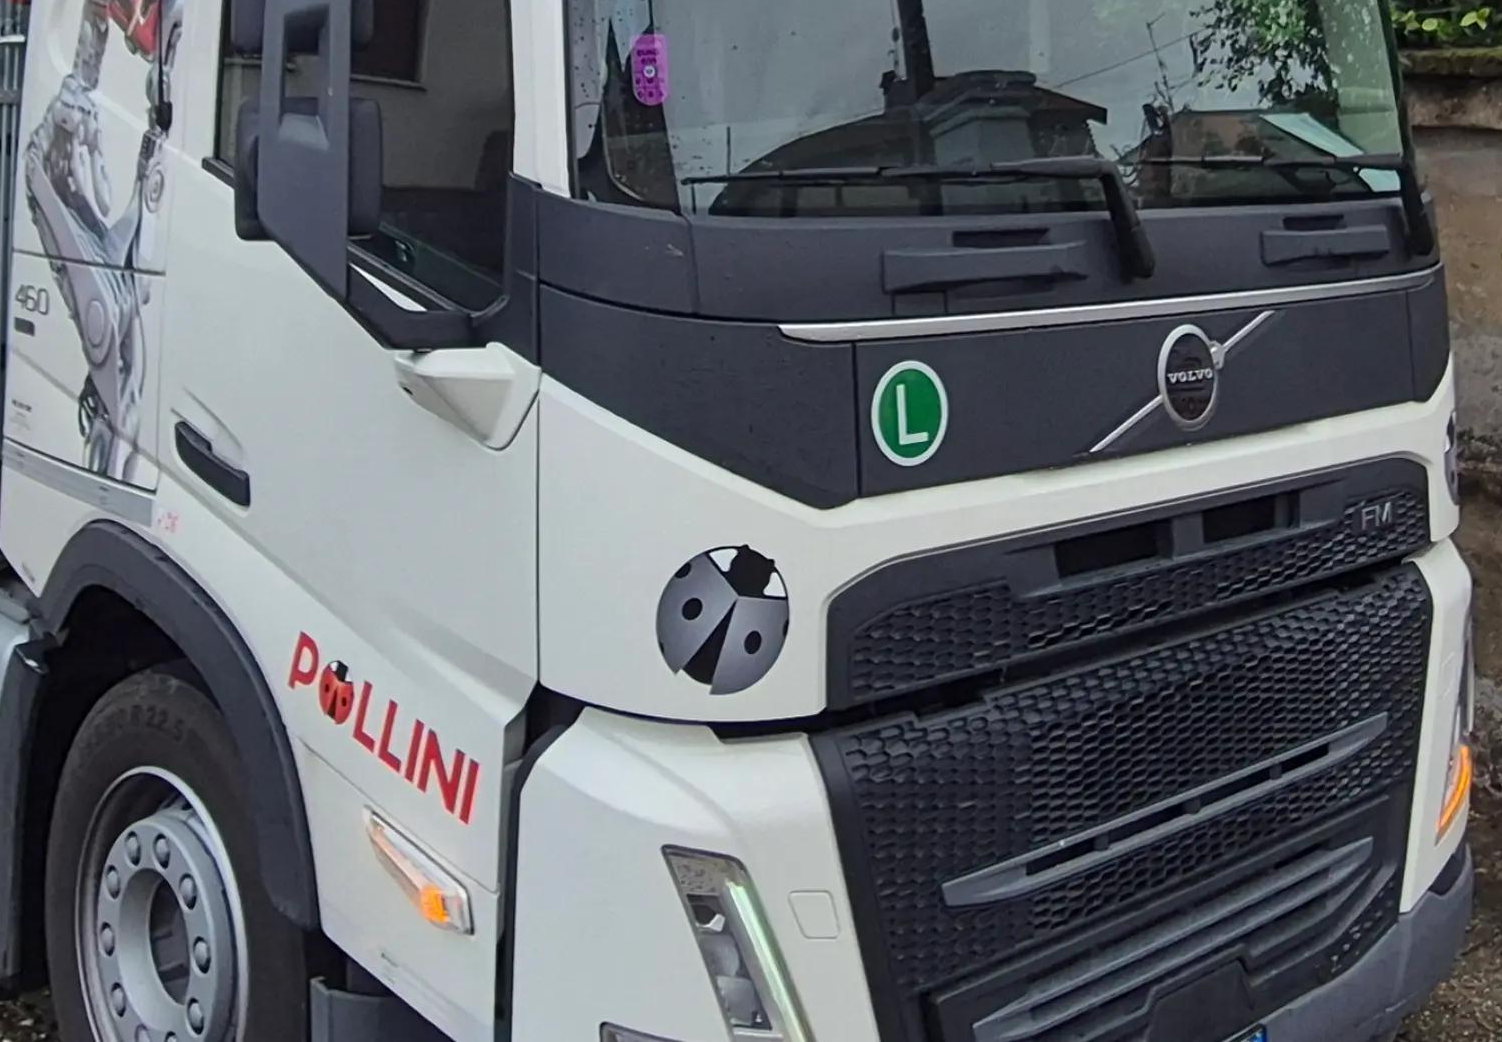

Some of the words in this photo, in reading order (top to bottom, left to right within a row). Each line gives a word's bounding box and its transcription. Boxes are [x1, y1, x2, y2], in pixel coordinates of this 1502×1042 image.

[15, 284, 50, 316] 460
[1167, 368, 1213, 384] VOLVO
[896, 383, 929, 445] L
[1361, 501, 1392, 531] FM
